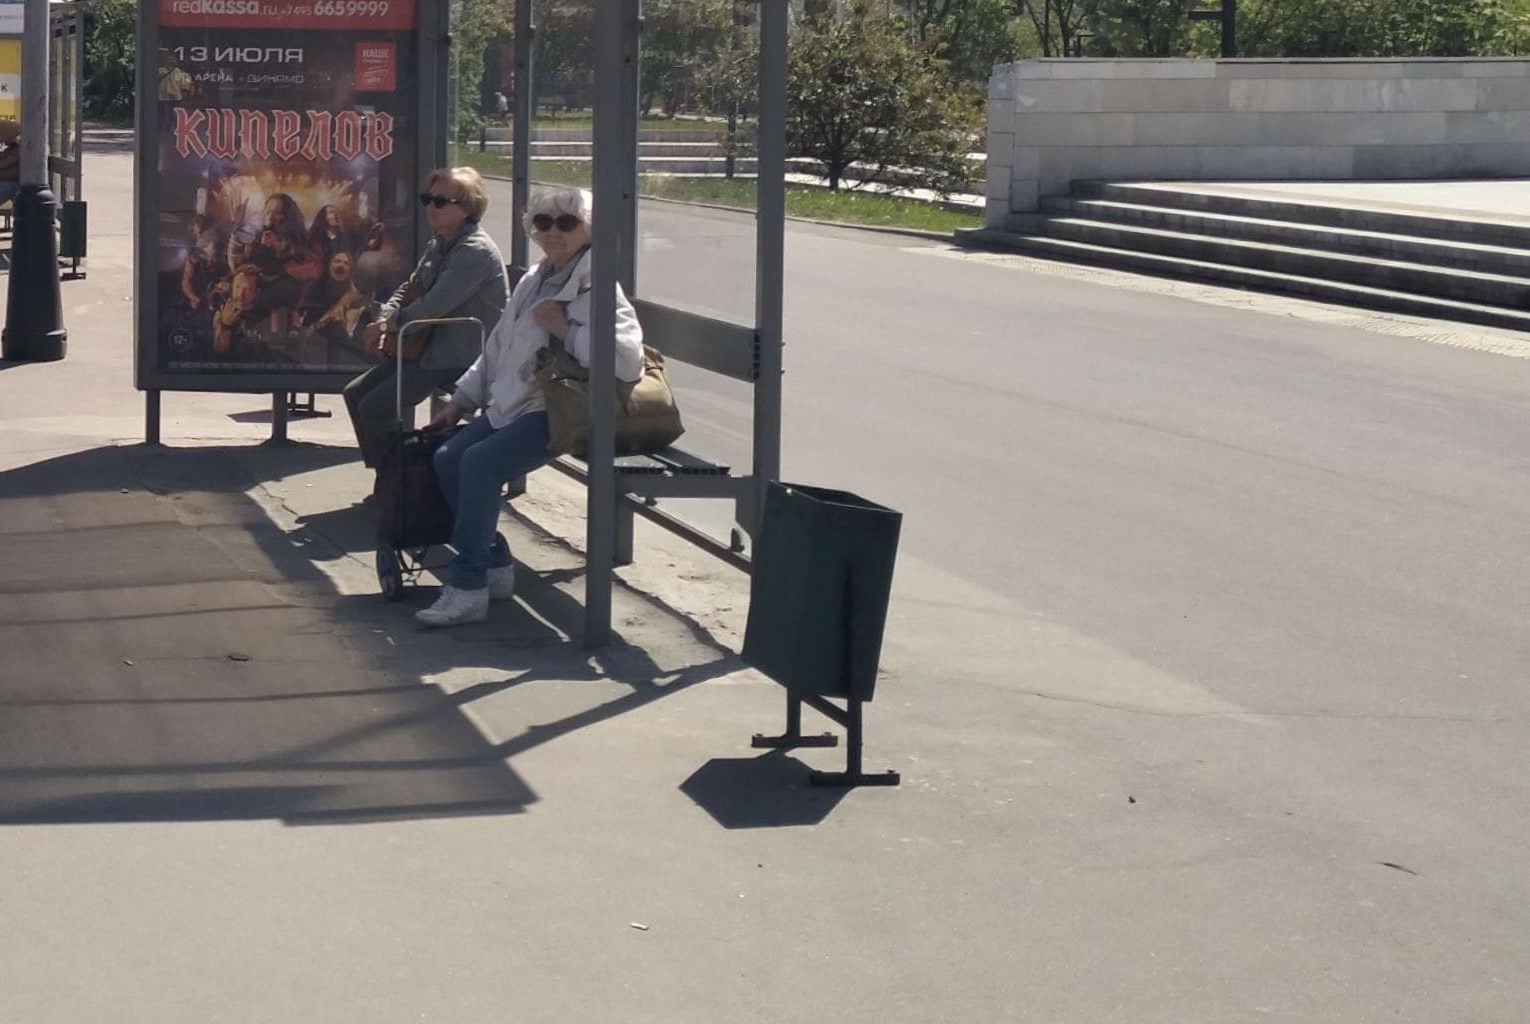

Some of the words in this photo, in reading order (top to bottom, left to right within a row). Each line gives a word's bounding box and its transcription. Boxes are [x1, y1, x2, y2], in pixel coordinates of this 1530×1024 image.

[314, 0, 389, 17] 6659999
[173, 46, 208, 62] 13
[214, 47, 304, 64] ИЮЛЯ
[174, 106, 394, 162] КИПЕЛОВ
